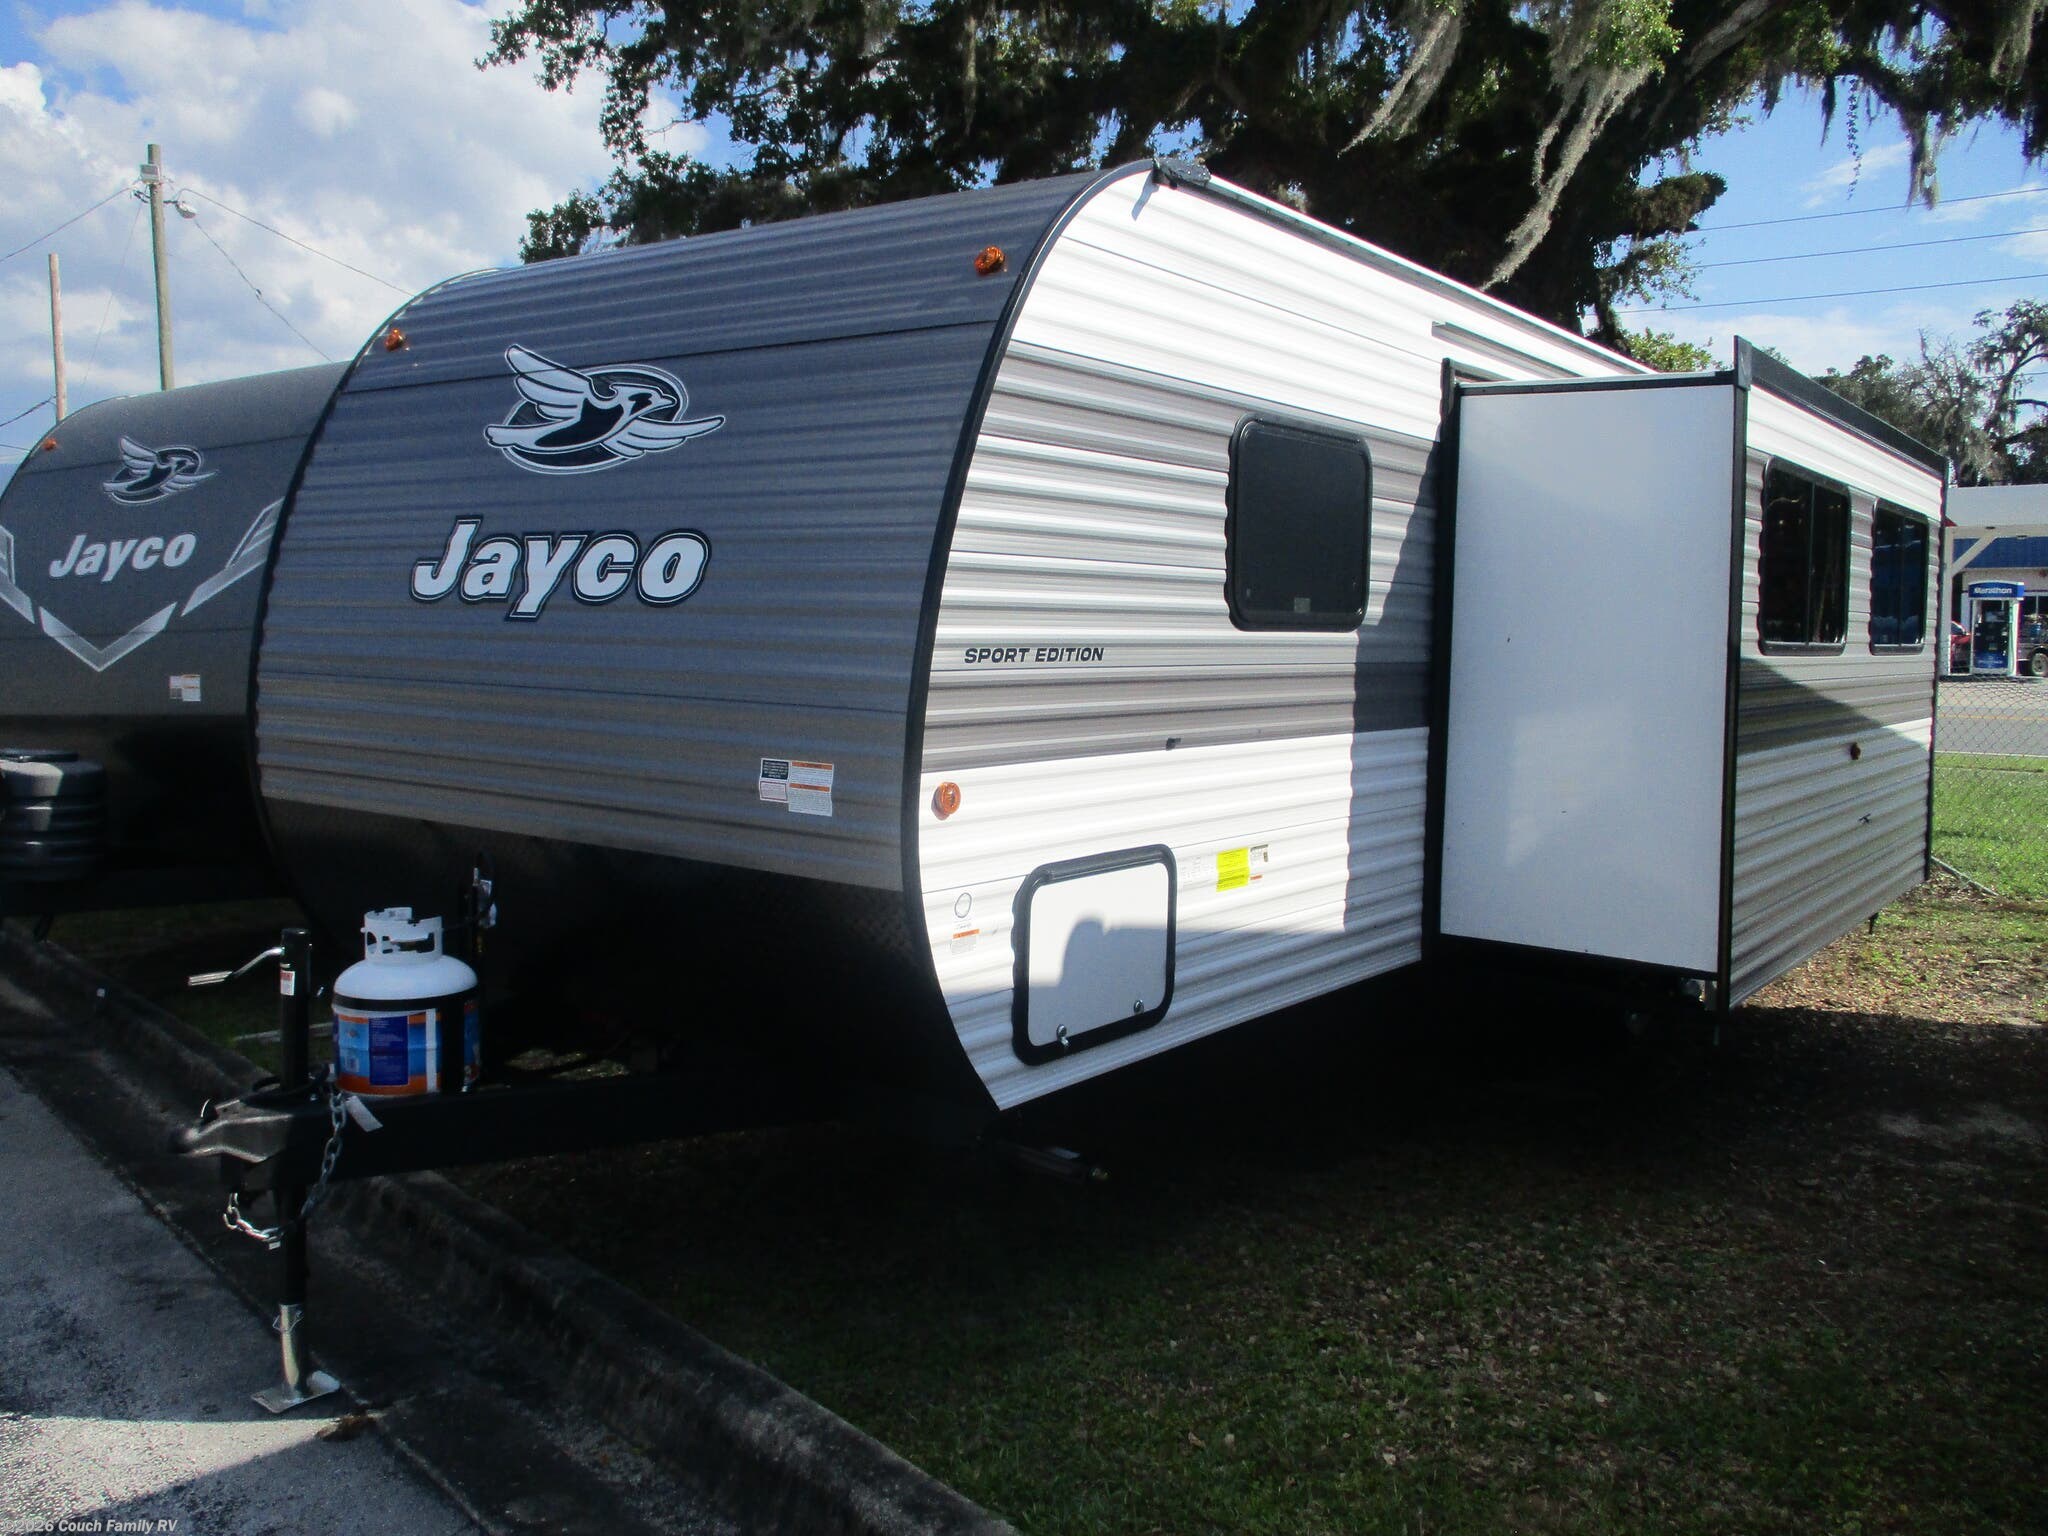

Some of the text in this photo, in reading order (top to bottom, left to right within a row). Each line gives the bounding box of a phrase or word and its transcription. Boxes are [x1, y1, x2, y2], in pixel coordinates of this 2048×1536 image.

[49, 534, 197, 582] Jayco
[410, 515, 711, 621] Jayco
[964, 648, 1104, 663] SPORT EDITION
